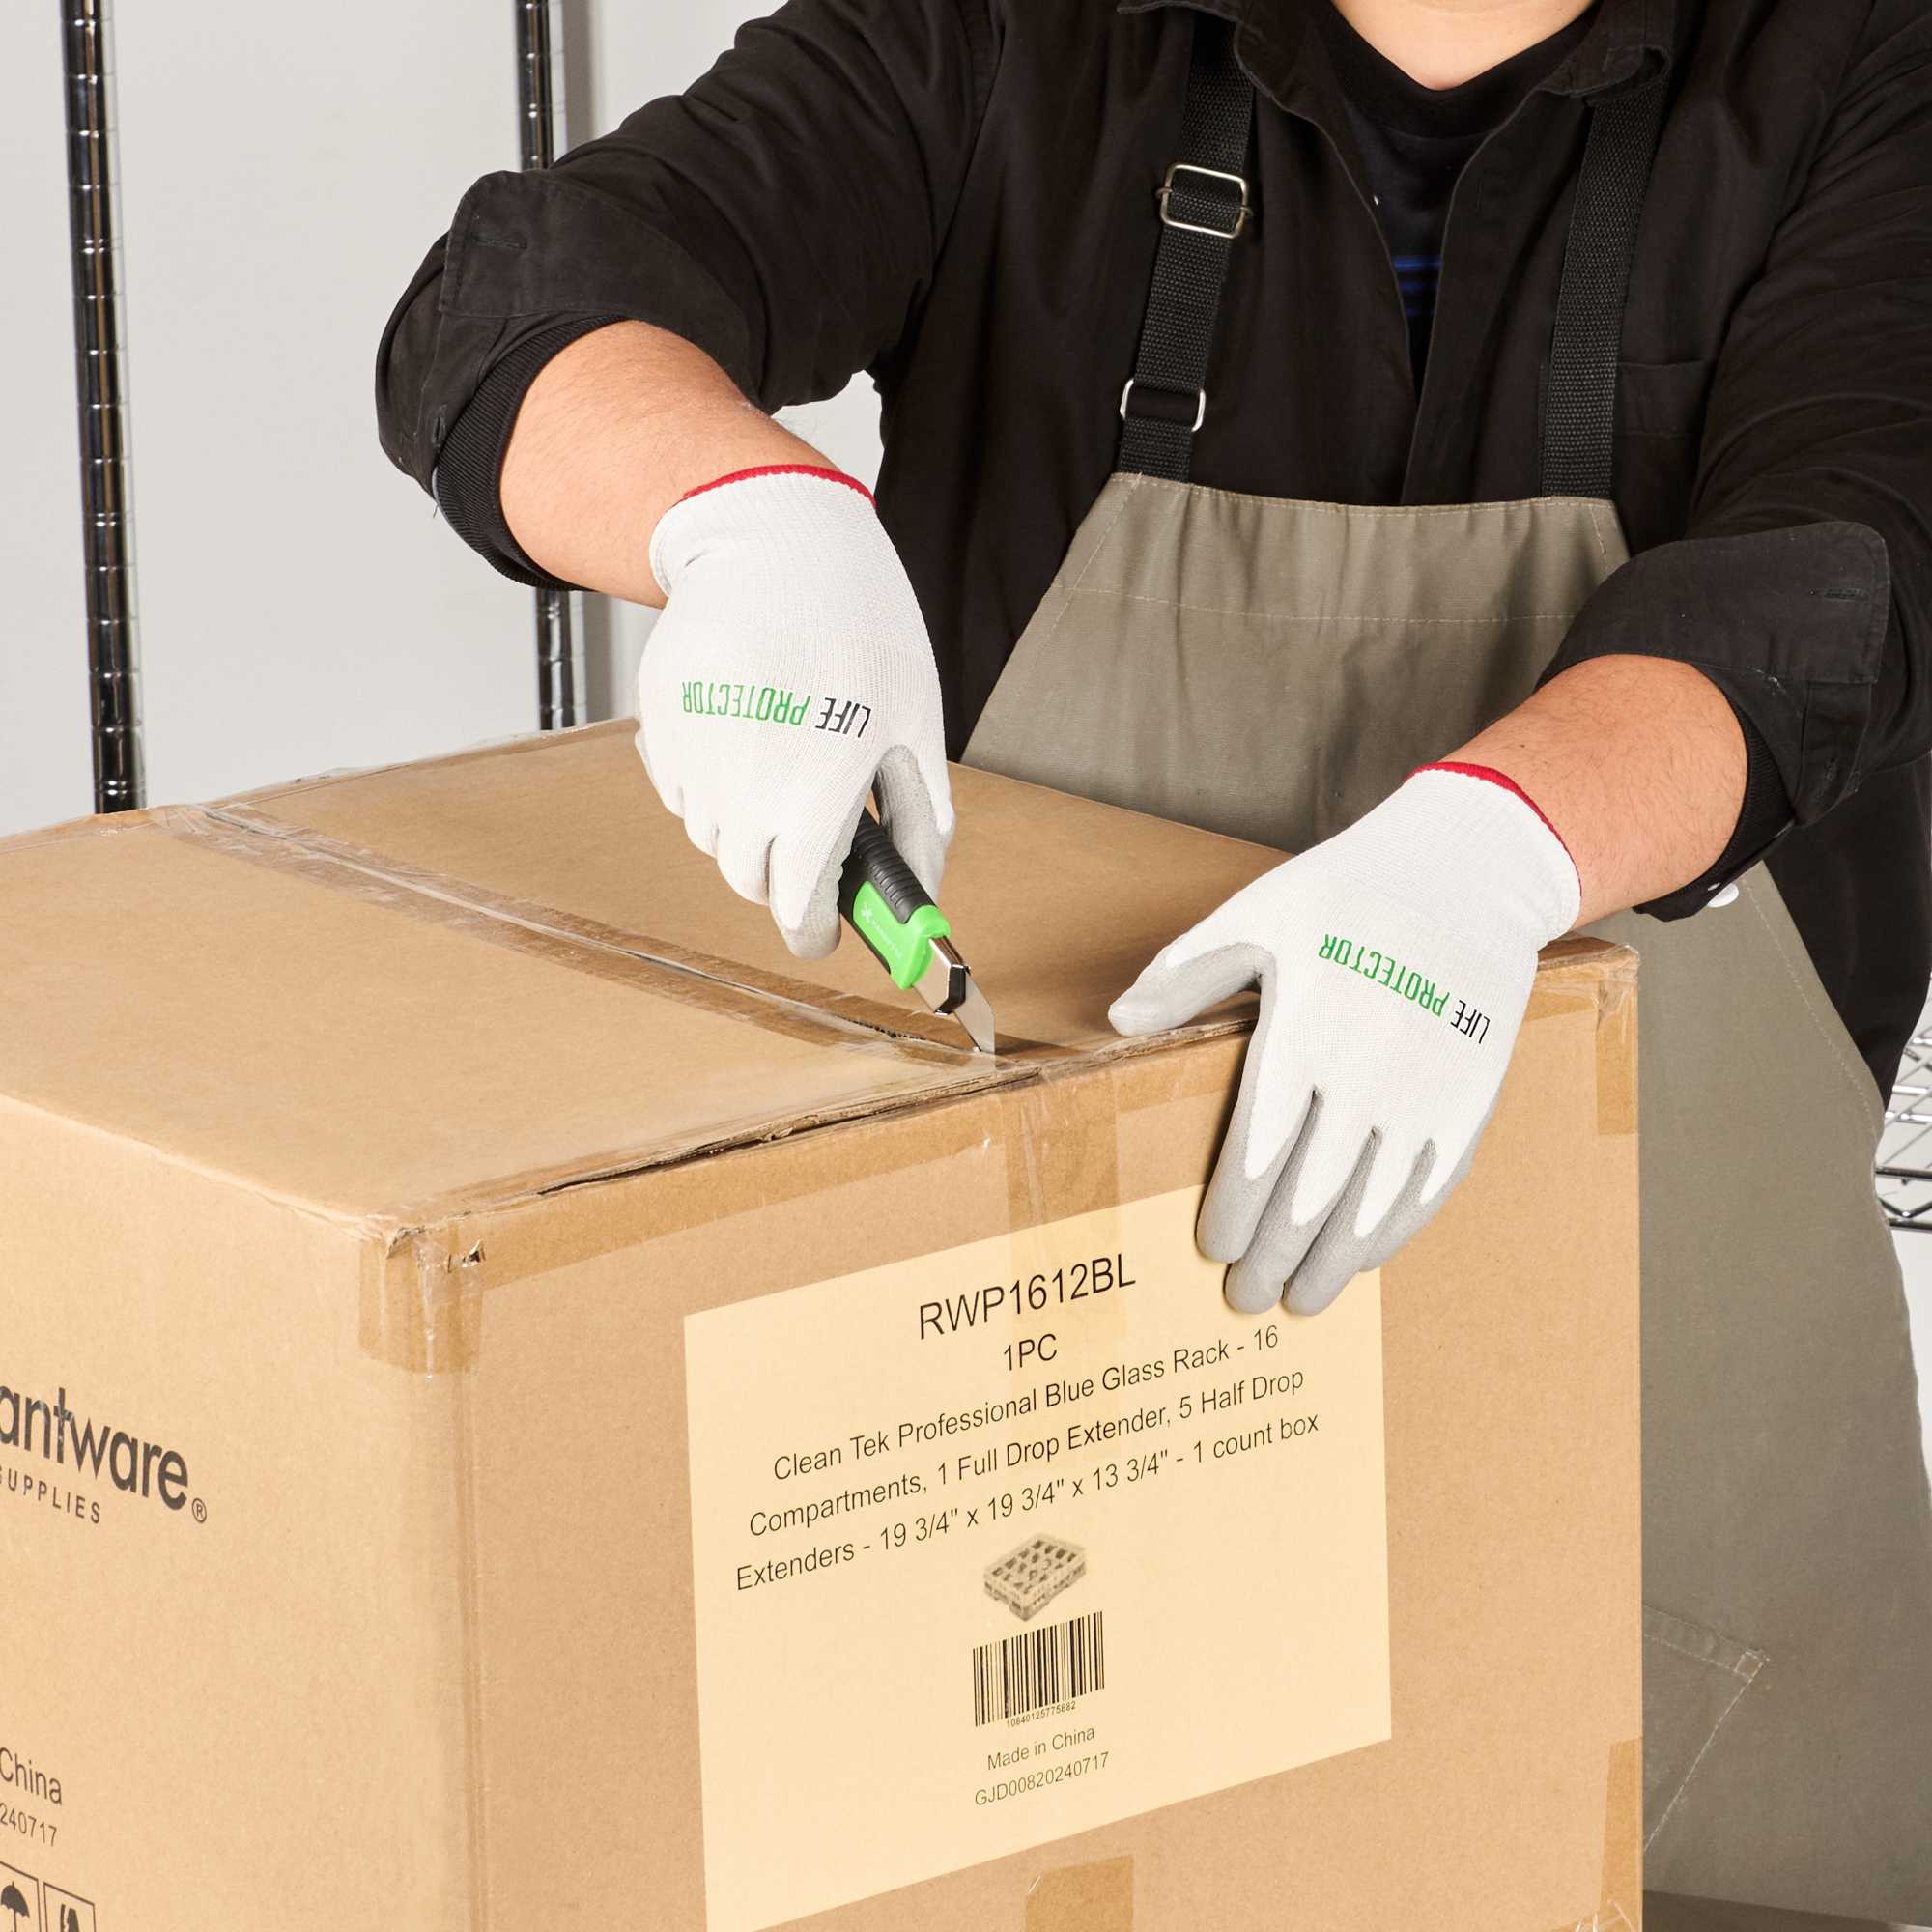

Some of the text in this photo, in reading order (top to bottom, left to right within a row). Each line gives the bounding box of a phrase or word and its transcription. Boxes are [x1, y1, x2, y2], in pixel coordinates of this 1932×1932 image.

[682, 681, 872, 738] LIFE PROTECTOR
[1318, 933, 1491, 1044] LIFE PROTECTOR
[919, 1252, 1137, 1341] RWP1612BL
[1003, 1332, 1058, 1372] 1PC
[773, 1447, 842, 1481] Clean
[849, 1430, 891, 1461] Tek
[898, 1387, 1037, 1449] Professional
[1045, 1378, 1094, 1408] Blue
[1101, 1359, 1165, 1391] Glass
[1173, 1338, 1230, 1374] Rack
[1253, 1324, 1279, 1351] 16
[749, 1369, 1304, 1537] Compartments, 1 Full Drop Extender, 5 Half Drop
[0, 1465, 101, 1524] UPPLIES
[736, 1542, 855, 1592] Extenders
[880, 1521, 907, 1551] 19
[915, 1507, 958, 1542] 3/4"
[966, 1506, 980, 1529] x
[987, 1492, 1013, 1521] 19
[1021, 1477, 1065, 1512] 3/4"
[1071, 1477, 1085, 1499] x
[1092, 1463, 1119, 1492] 13
[1126, 1448, 1168, 1483] 3/4"
[1193, 1439, 1203, 1463] 1
[1212, 1422, 1274, 1459] count
[1280, 1413, 1320, 1441] box
[1006, 1700, 1077, 1729] 10840125775882
[0, 1747, 62, 1805] China
[987, 1726, 1095, 1771] Made in China
[974, 1750, 1110, 1806] GJD00820240717
[0, 1802, 57, 1847] 240717
